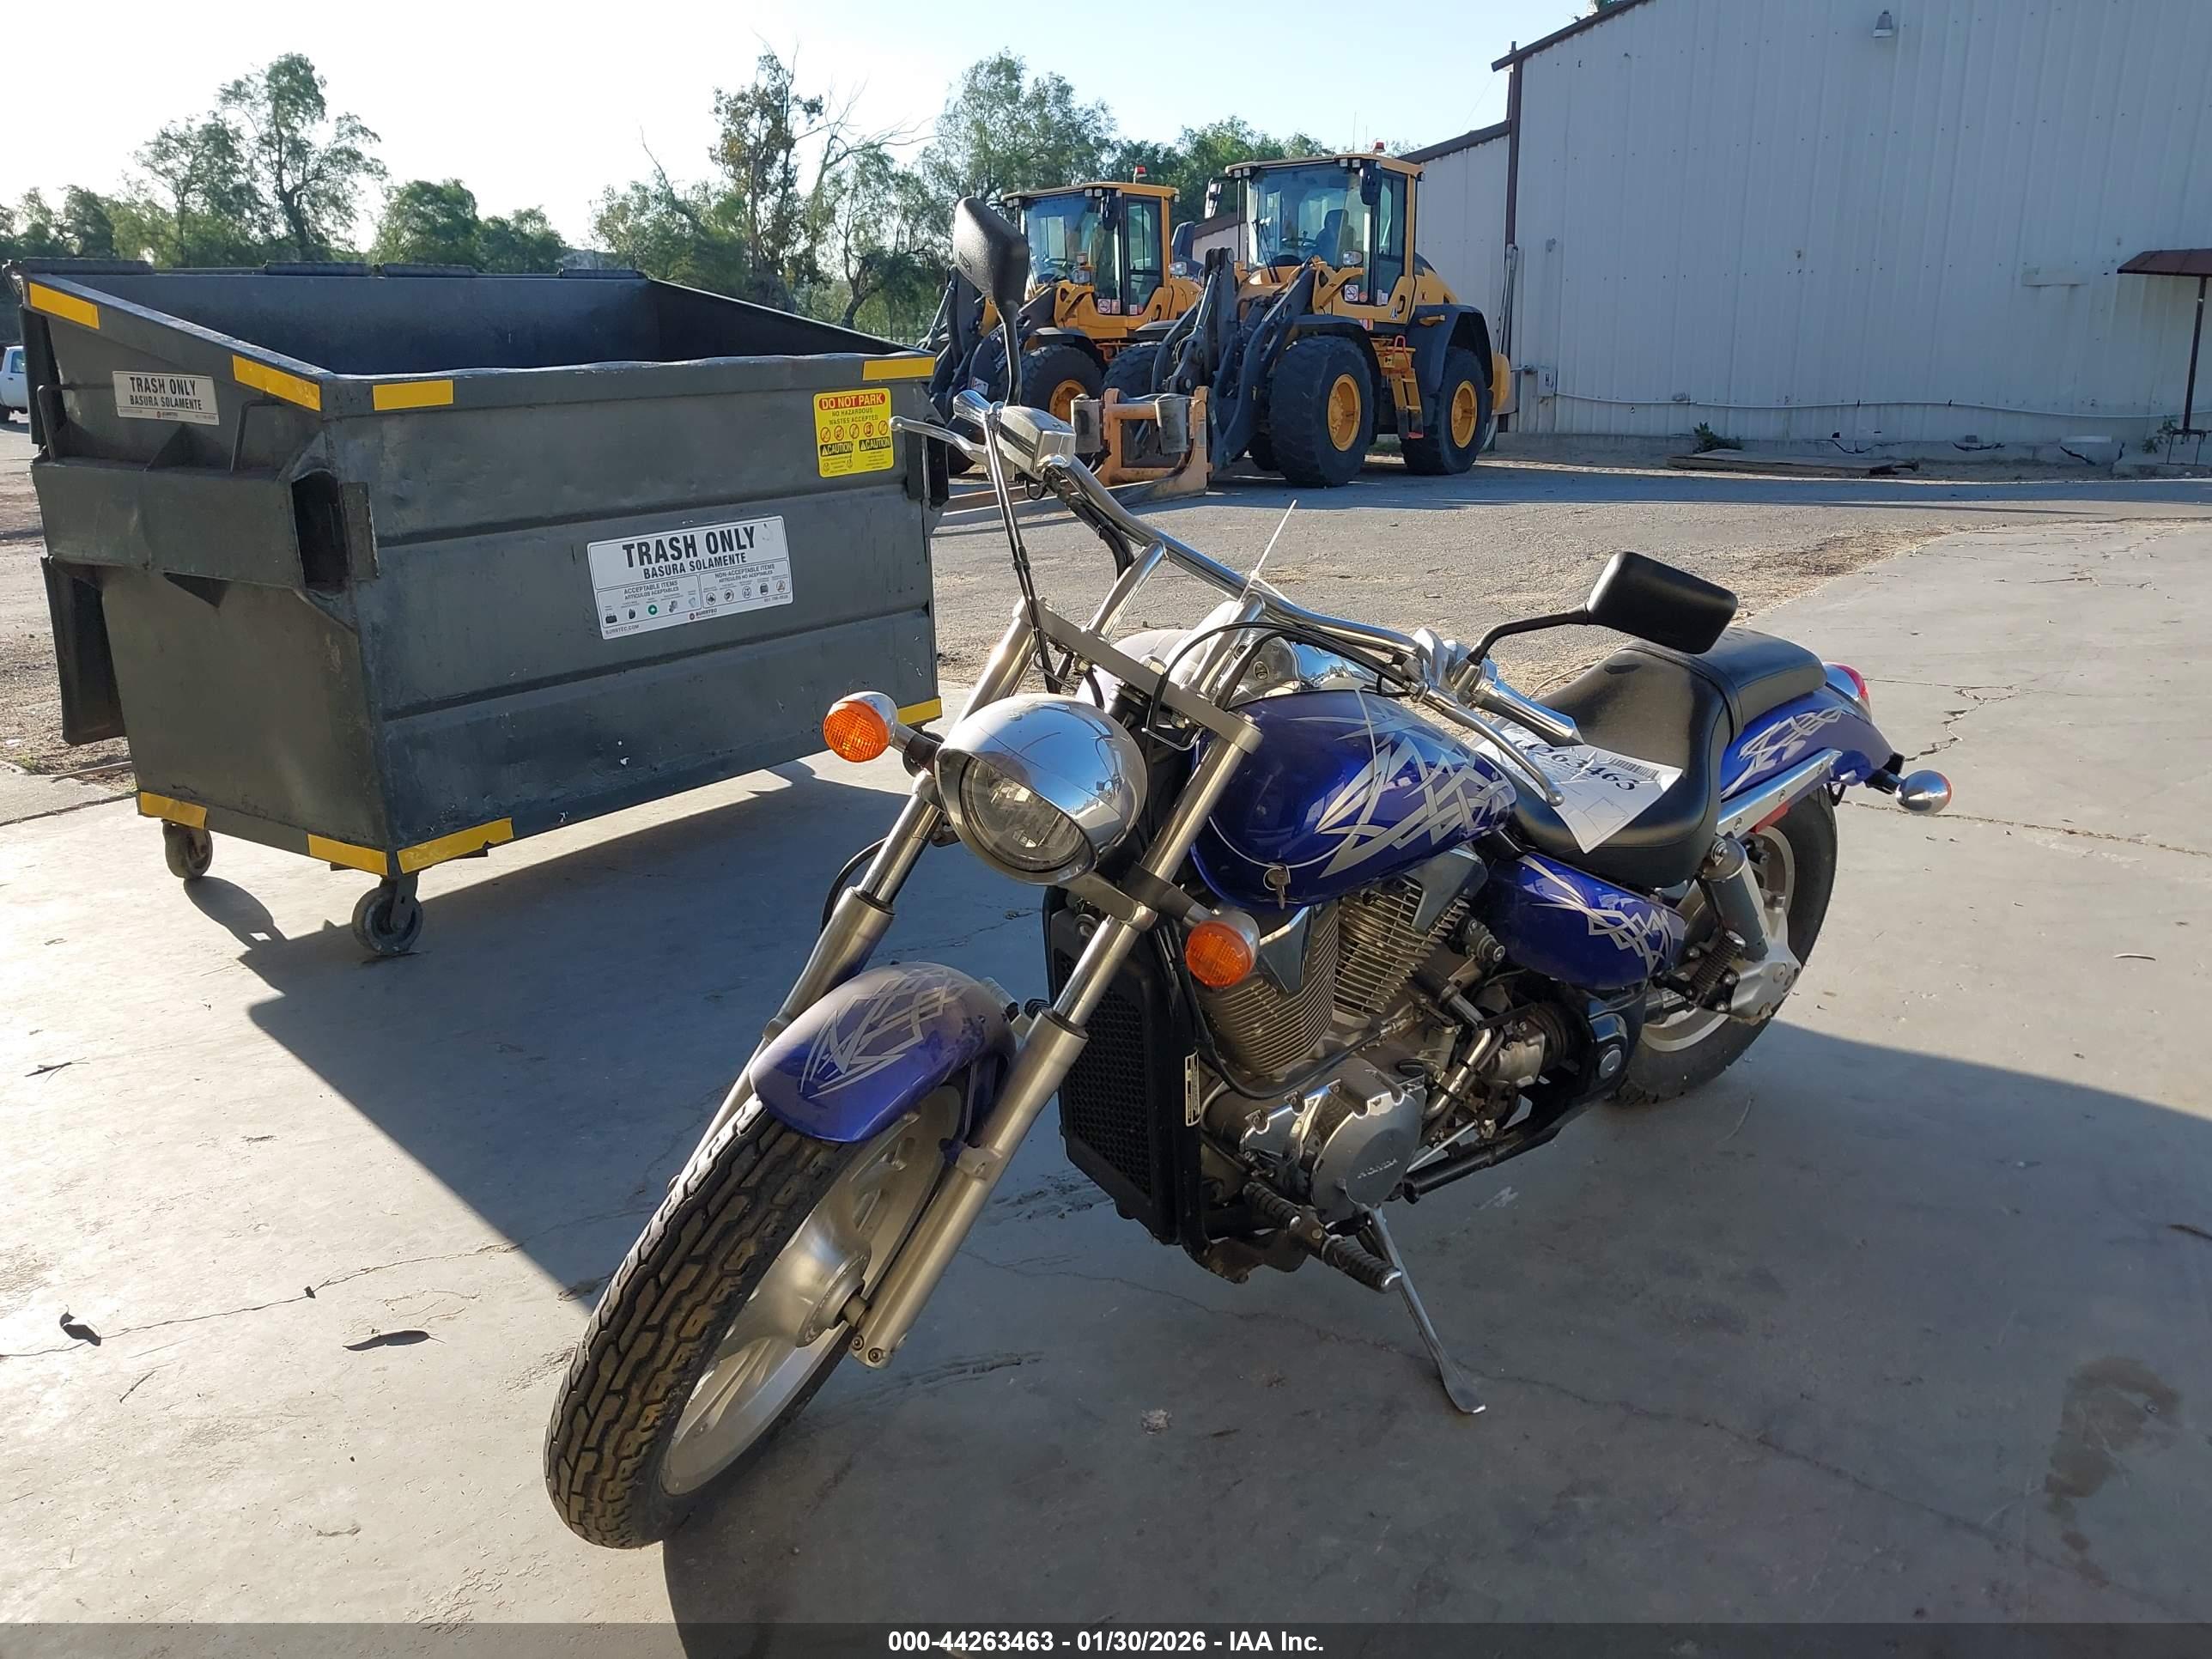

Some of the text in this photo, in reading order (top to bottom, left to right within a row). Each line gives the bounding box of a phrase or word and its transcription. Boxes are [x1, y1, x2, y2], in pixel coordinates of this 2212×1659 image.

[130, 376, 197, 396] TRASH ONLY
[130, 395, 203, 410] BASURA SOLAMENTE
[821, 393, 884, 410] DO NOT PARK
[841, 407, 873, 416] HAZARDOUS
[827, 442, 853, 454] CAUTION
[865, 438, 890, 450] CAUTION
[623, 526, 756, 568] TRASH ONLY
[643, 552, 747, 580] BASURA SOLAMENTE
[714, 566, 760, 579] NON-ACCEPTABLE
[760, 563, 775, 572] ITEMS
[623, 580, 678, 594] ACCEPTABLE ITEMS
[1513, 739, 1641, 791] 263463
